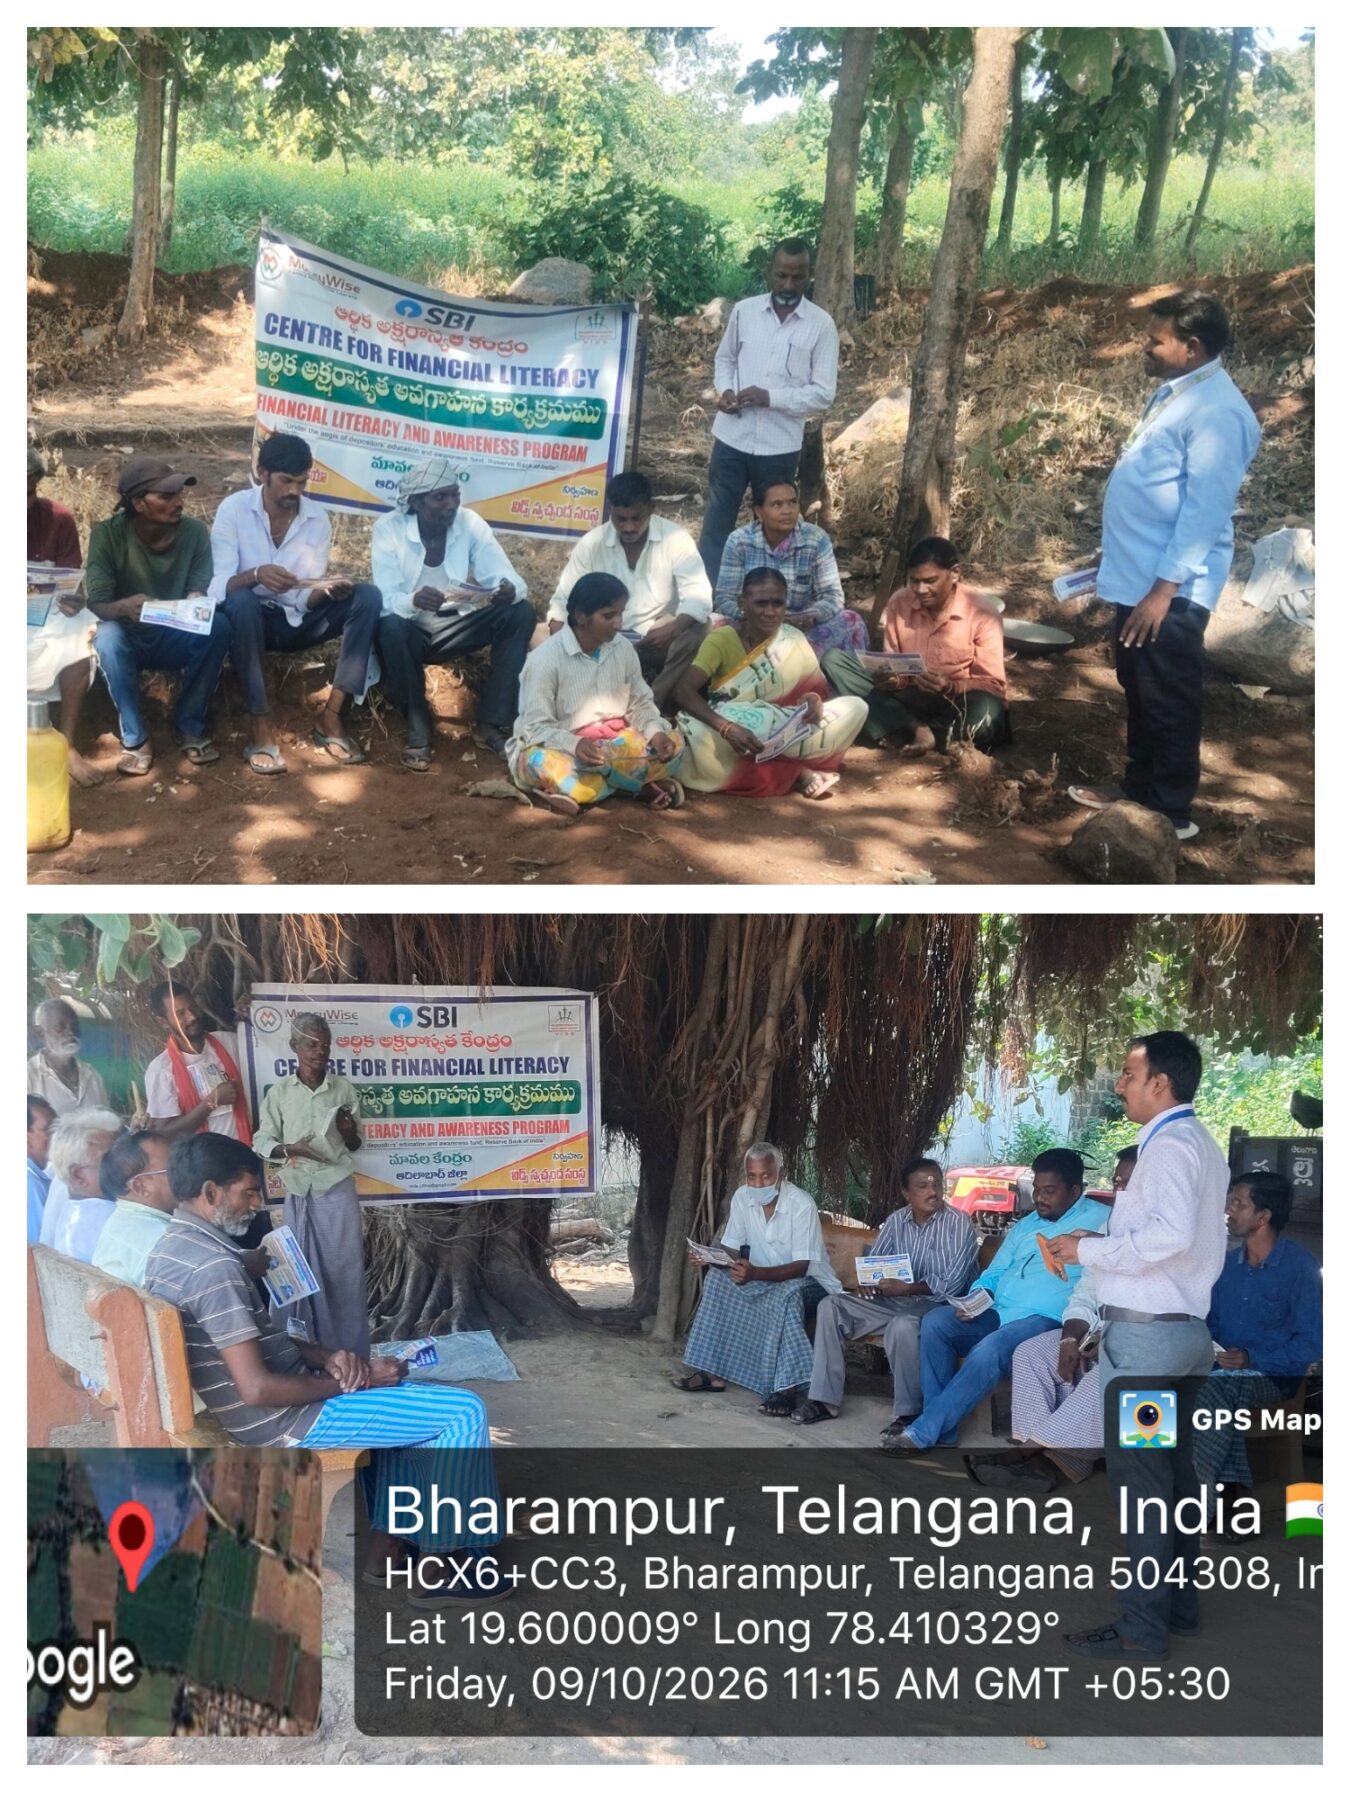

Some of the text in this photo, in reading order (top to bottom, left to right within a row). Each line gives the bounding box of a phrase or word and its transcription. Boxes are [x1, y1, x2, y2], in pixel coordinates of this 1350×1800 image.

[425, 307, 476, 332] SBI
[264, 312, 599, 390] CENTRE FOR FINANCIAL LITERACY
[394, 383, 487, 415] అవగాహన
[490, 395, 601, 430] కార్యక్రమము
[257, 393, 588, 463] FINANCIAL LITERACY AND AWARENESS PROGRAM
[417, 1006, 457, 1028] SBI
[379, 1034, 457, 1055] అక్షరాస్యత
[461, 1030, 512, 1052] కేంద్రం
[274, 1056, 570, 1077] CERE FOR FINANCIAL LITERACY
[398, 1085, 481, 1105] అవగాహన
[483, 1083, 576, 1111] కార్యక్రమము
[362, 1119, 570, 1139] TERACY AND AWARENESS PROGRAM
[389, 1151, 472, 1167] మావల కేంద్రం
[396, 1168, 446, 1180] ఆదిలాబాద్
